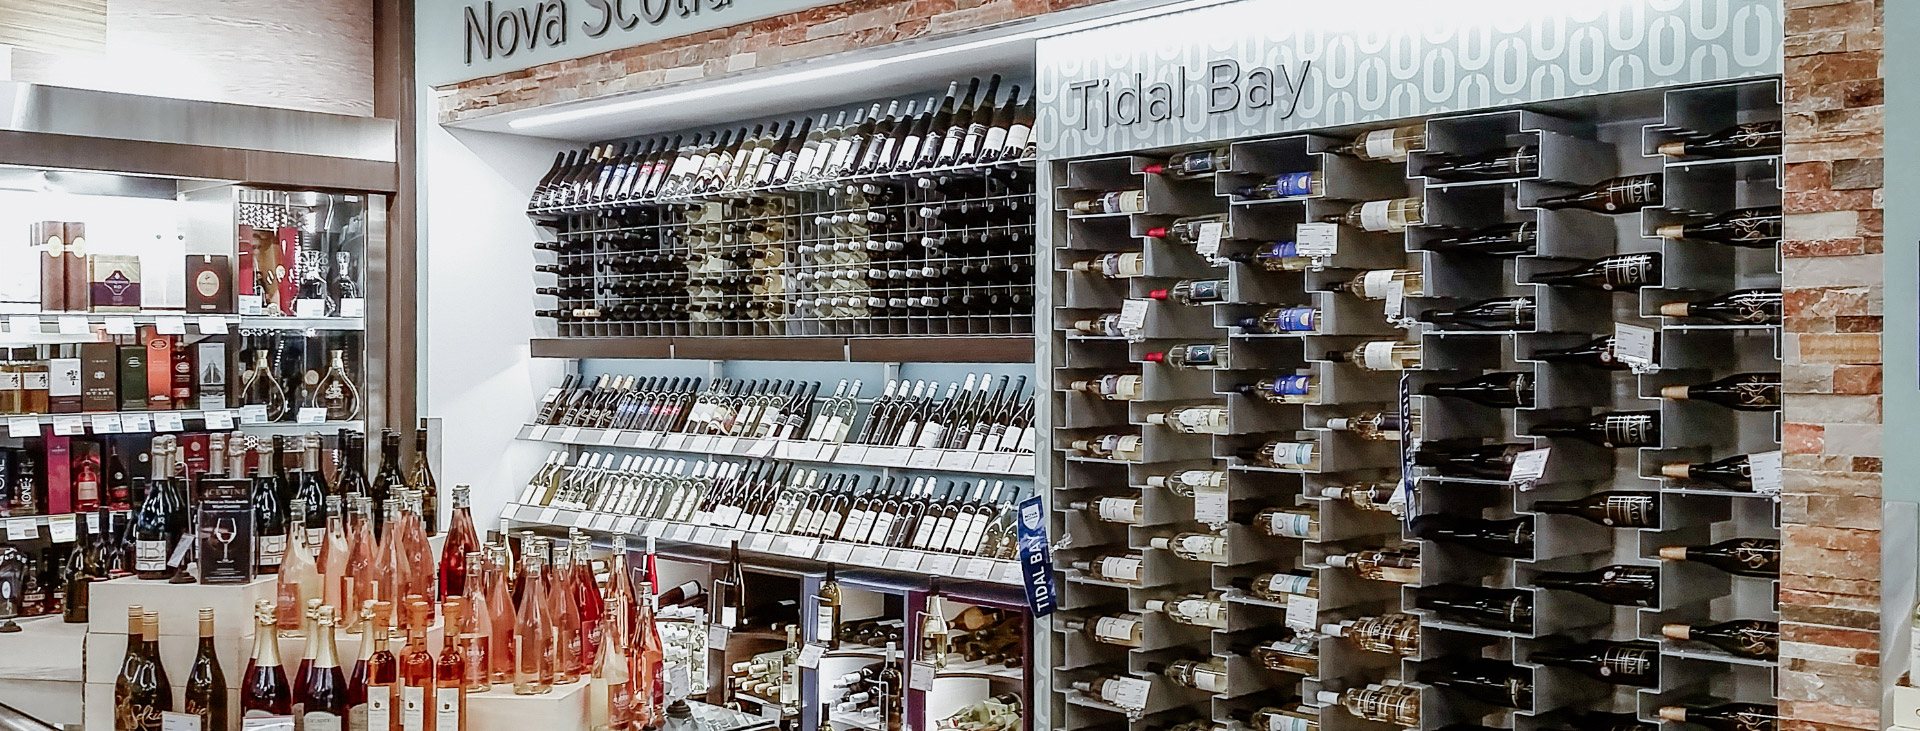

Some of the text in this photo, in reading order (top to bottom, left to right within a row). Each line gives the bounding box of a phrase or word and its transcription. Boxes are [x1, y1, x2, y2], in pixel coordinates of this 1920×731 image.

[464, 0, 734, 66] Nova Sco
[1070, 58, 1311, 130] Tidal Bay
[1027, 535, 1043, 565] BAY
[1033, 566, 1051, 613] TIDAL
